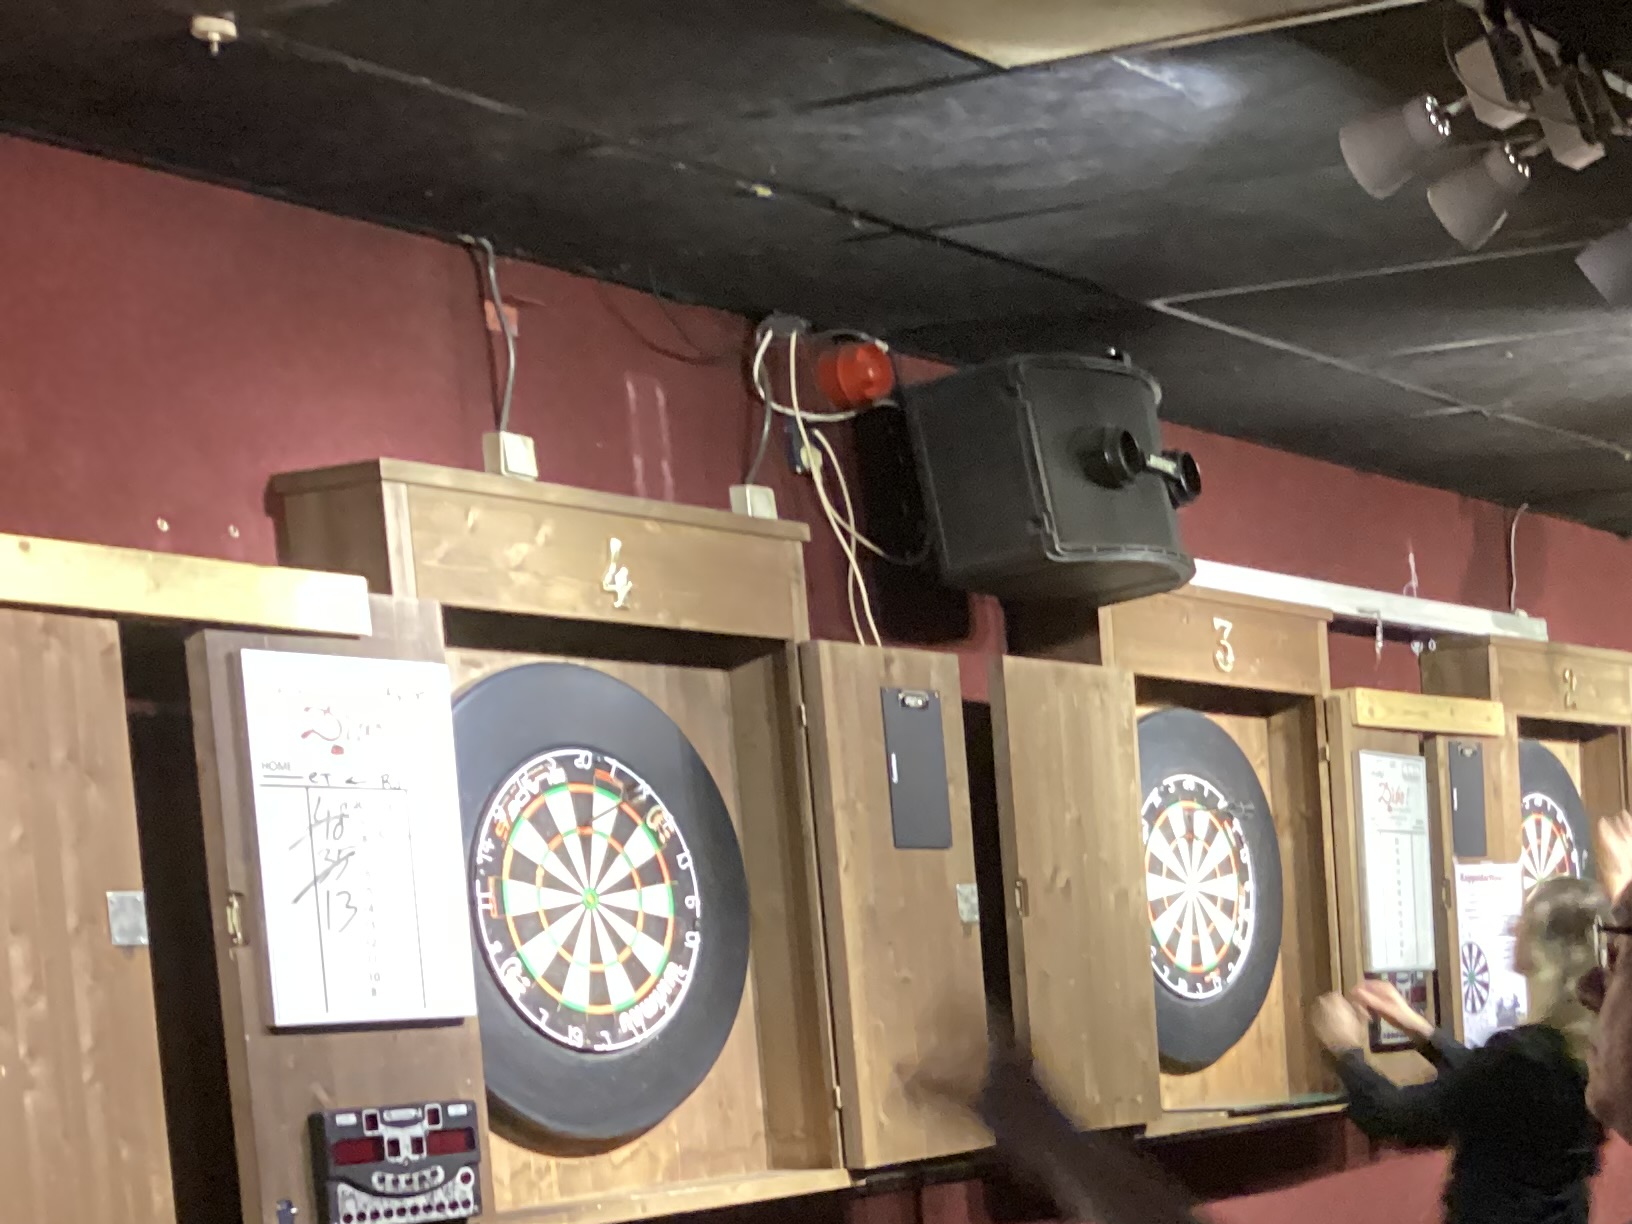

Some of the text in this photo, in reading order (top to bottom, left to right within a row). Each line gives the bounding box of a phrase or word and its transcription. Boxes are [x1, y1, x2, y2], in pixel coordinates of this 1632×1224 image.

[603, 537, 633, 608] 4
[1211, 616, 1235, 673] 3
[1563, 667, 1578, 711] 2
[326, 889, 357, 933] 13
